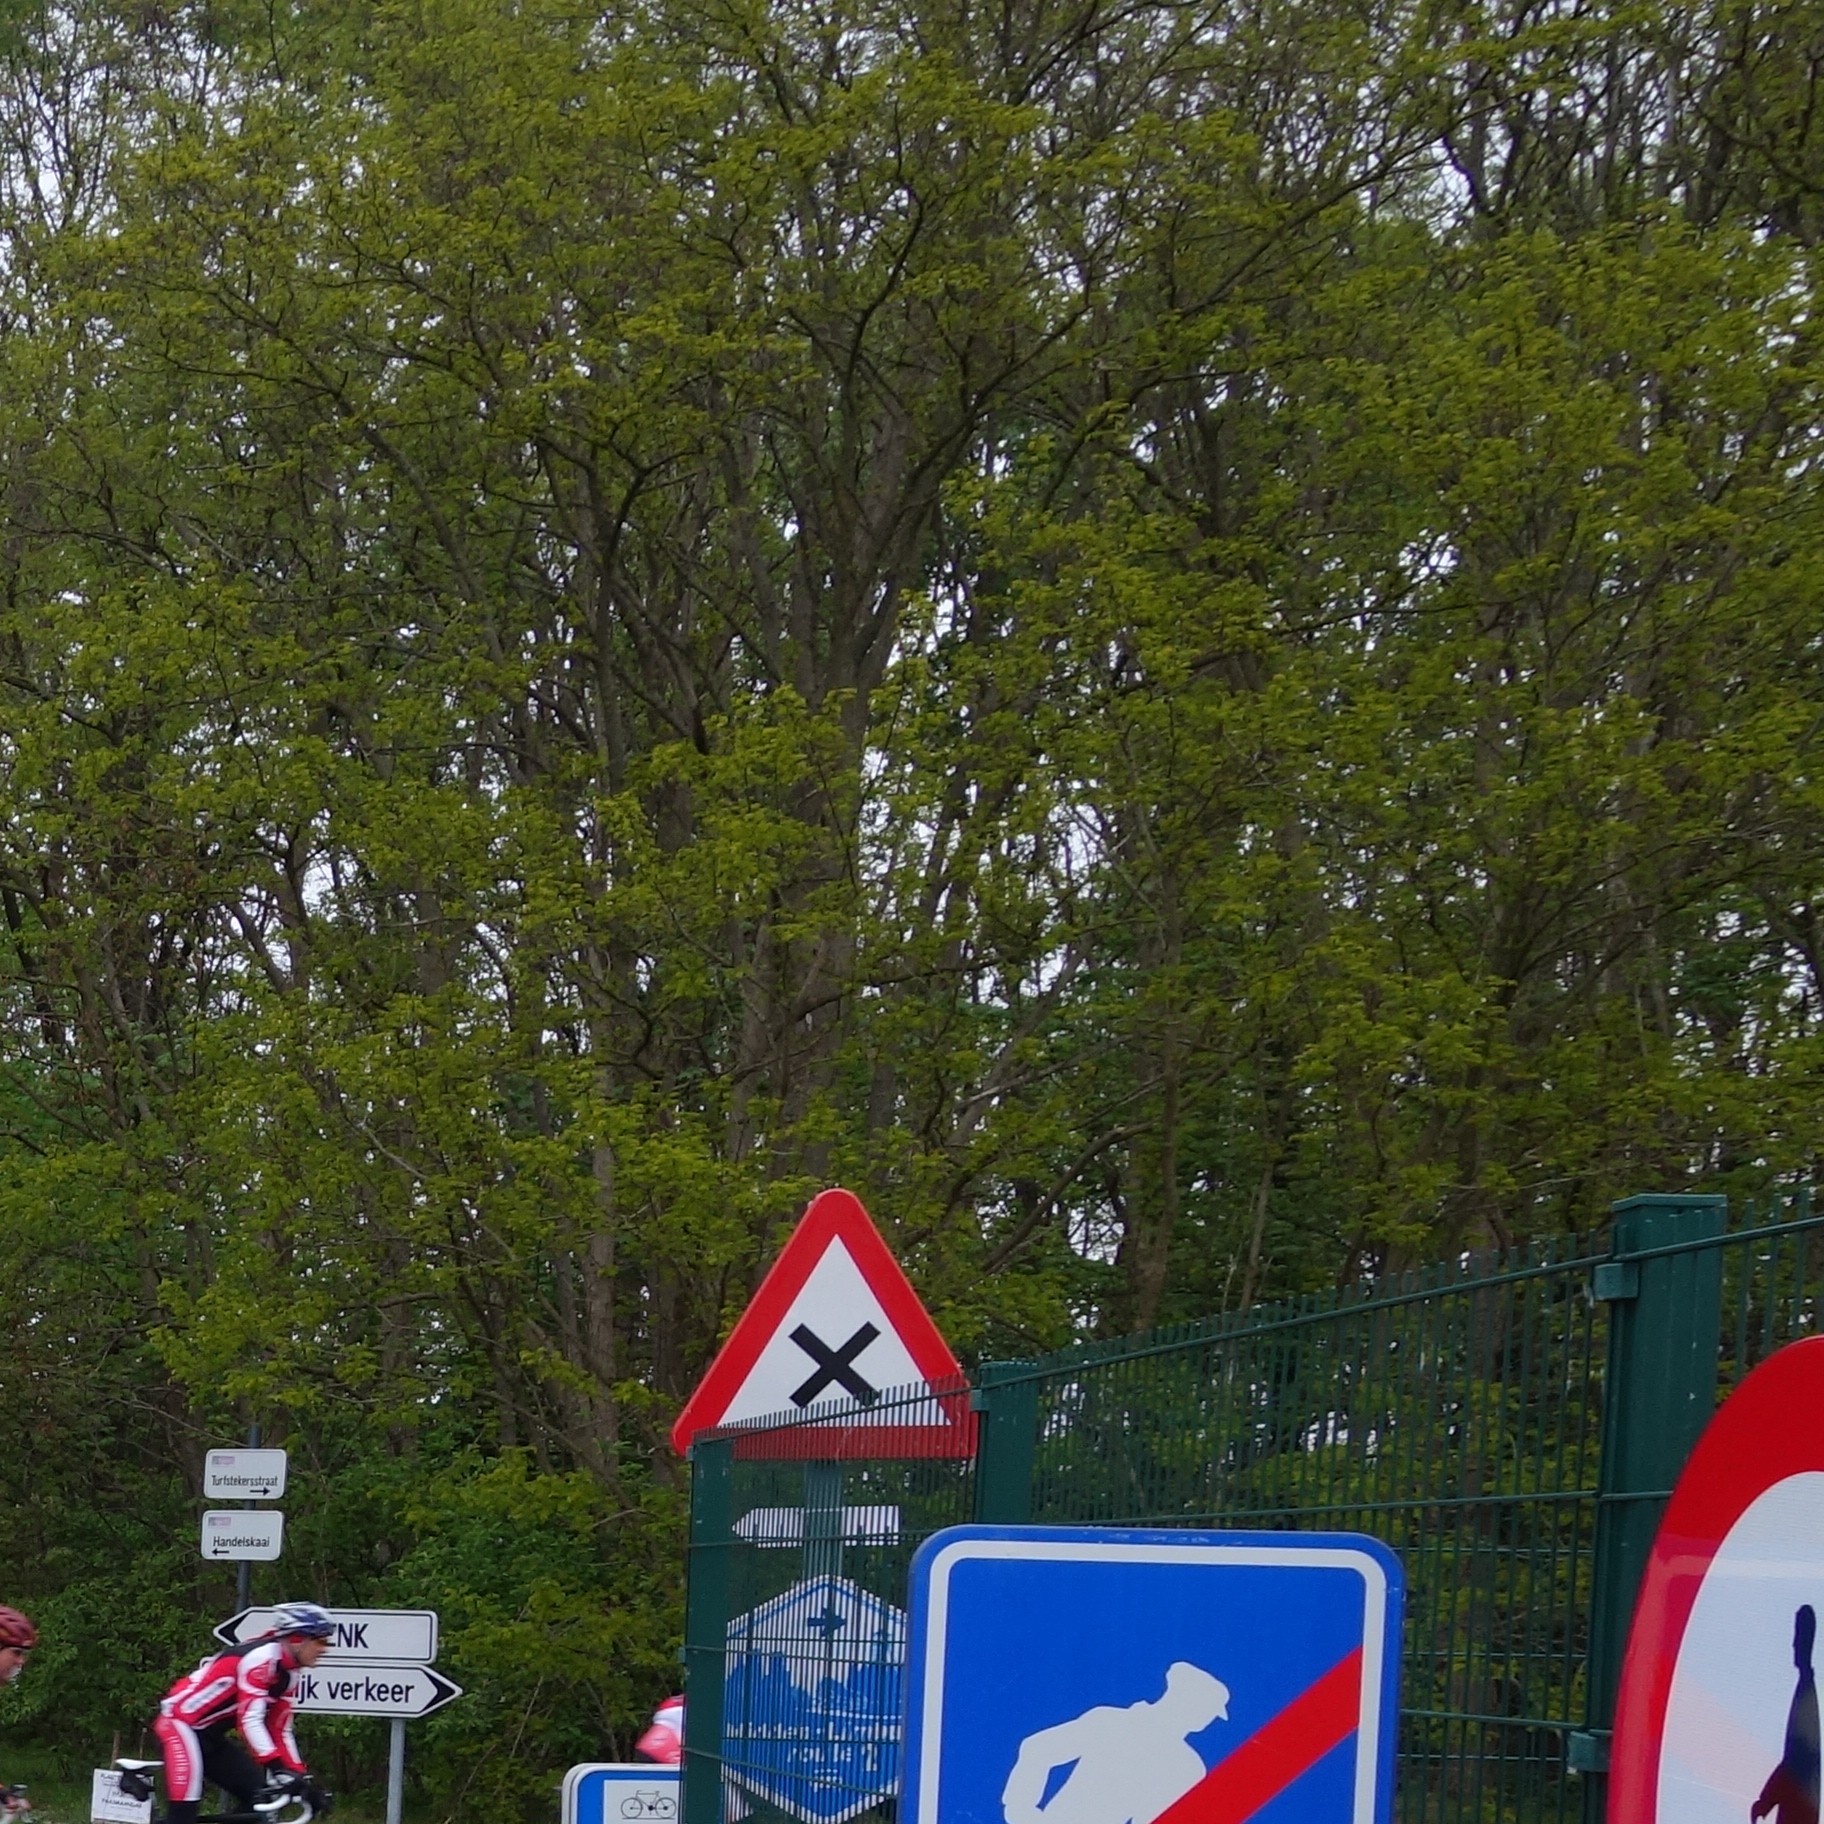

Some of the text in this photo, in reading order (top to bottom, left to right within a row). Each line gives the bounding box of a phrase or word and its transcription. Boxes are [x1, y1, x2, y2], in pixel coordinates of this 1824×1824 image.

[211, 1475, 278, 1487] Turfstekersstraat
[212, 1536, 270, 1547] Handelskaai
[327, 1675, 415, 1703] verkeer
